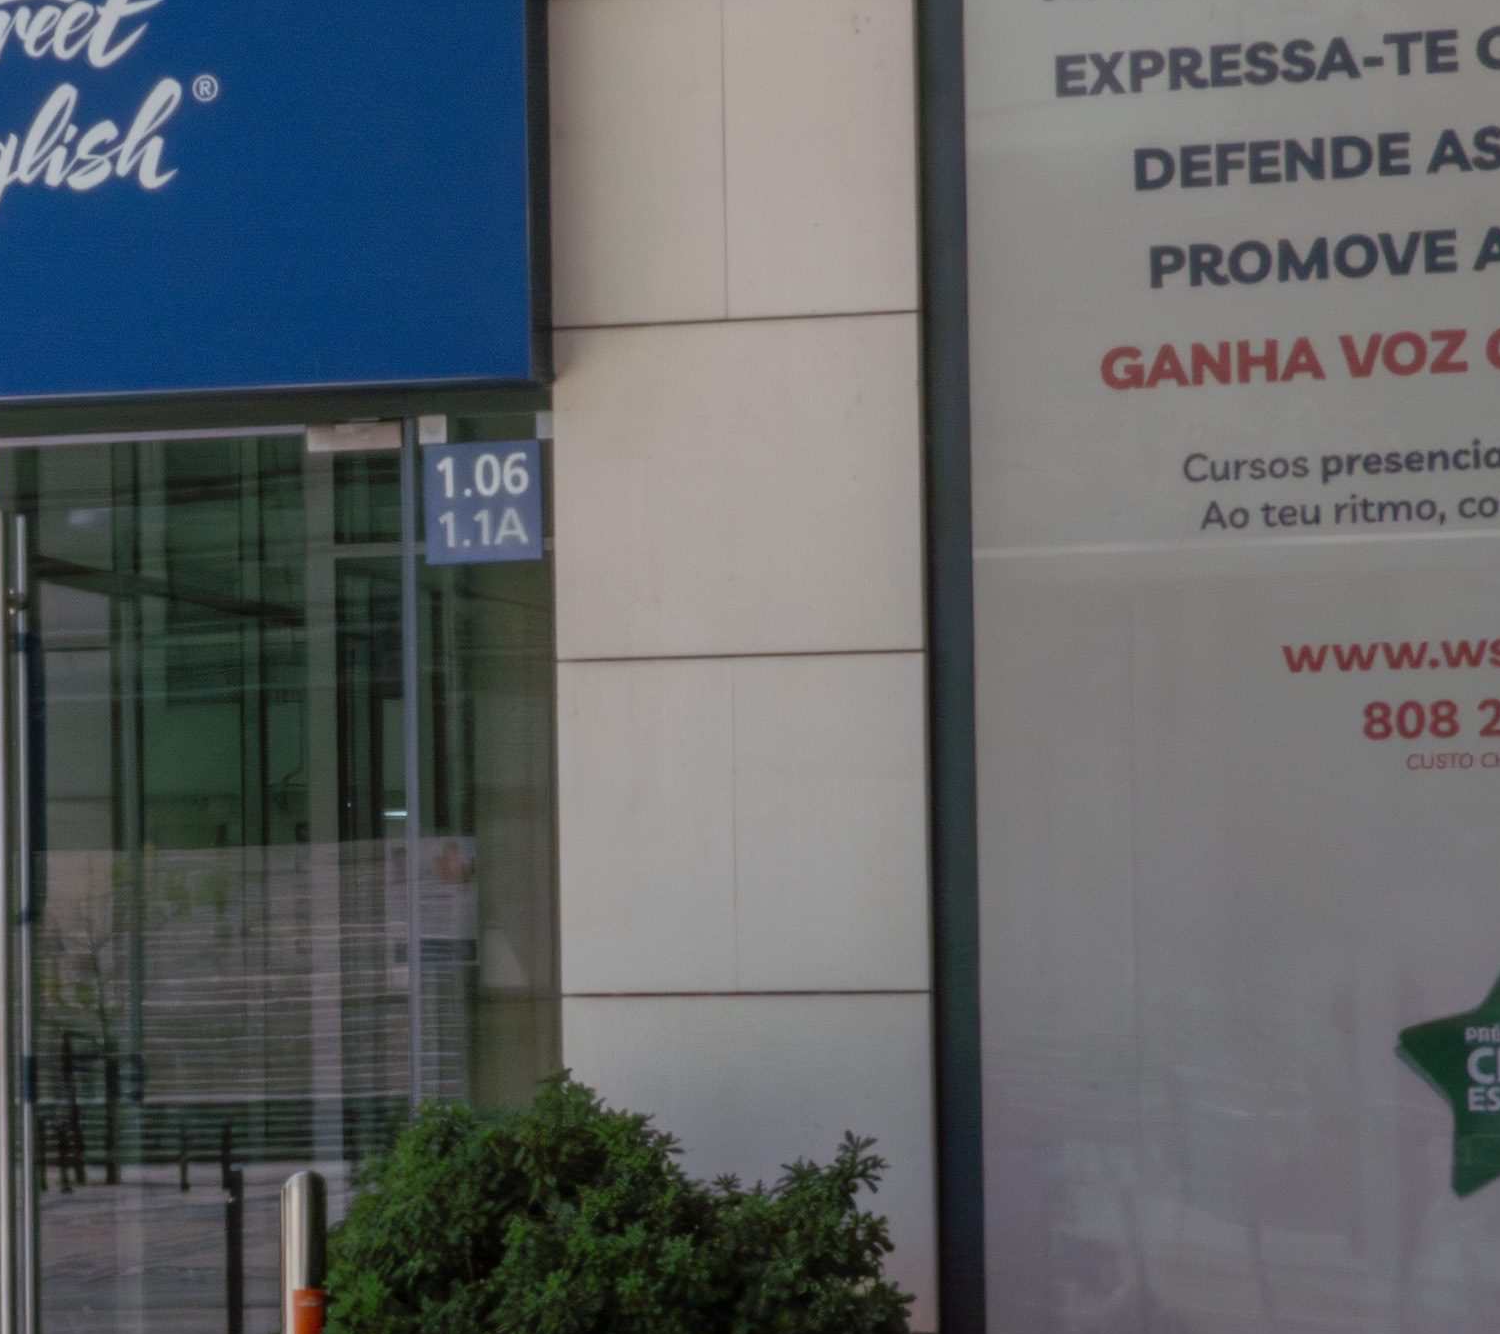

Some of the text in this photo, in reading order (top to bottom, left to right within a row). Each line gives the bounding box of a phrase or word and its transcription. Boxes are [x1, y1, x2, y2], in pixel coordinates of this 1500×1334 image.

[1054, 27, 1461, 99] EXPRESSA-TE
[1133, 130, 1413, 192] DEFENDE
[1149, 228, 1459, 290] PROMOVE
[1099, 335, 1327, 391] GANHA
[1338, 328, 1470, 379] VOZ
[435, 451, 530, 500] 1.06
[1182, 452, 1311, 483] Cursos
[437, 505, 530, 549] 1.1A
[1200, 500, 1250, 531] Ao
[1260, 502, 1322, 528] teu
[1334, 493, 1447, 526] ritmo,
[1362, 698, 1461, 741] 808
[1406, 751, 1476, 772] CUSTO
